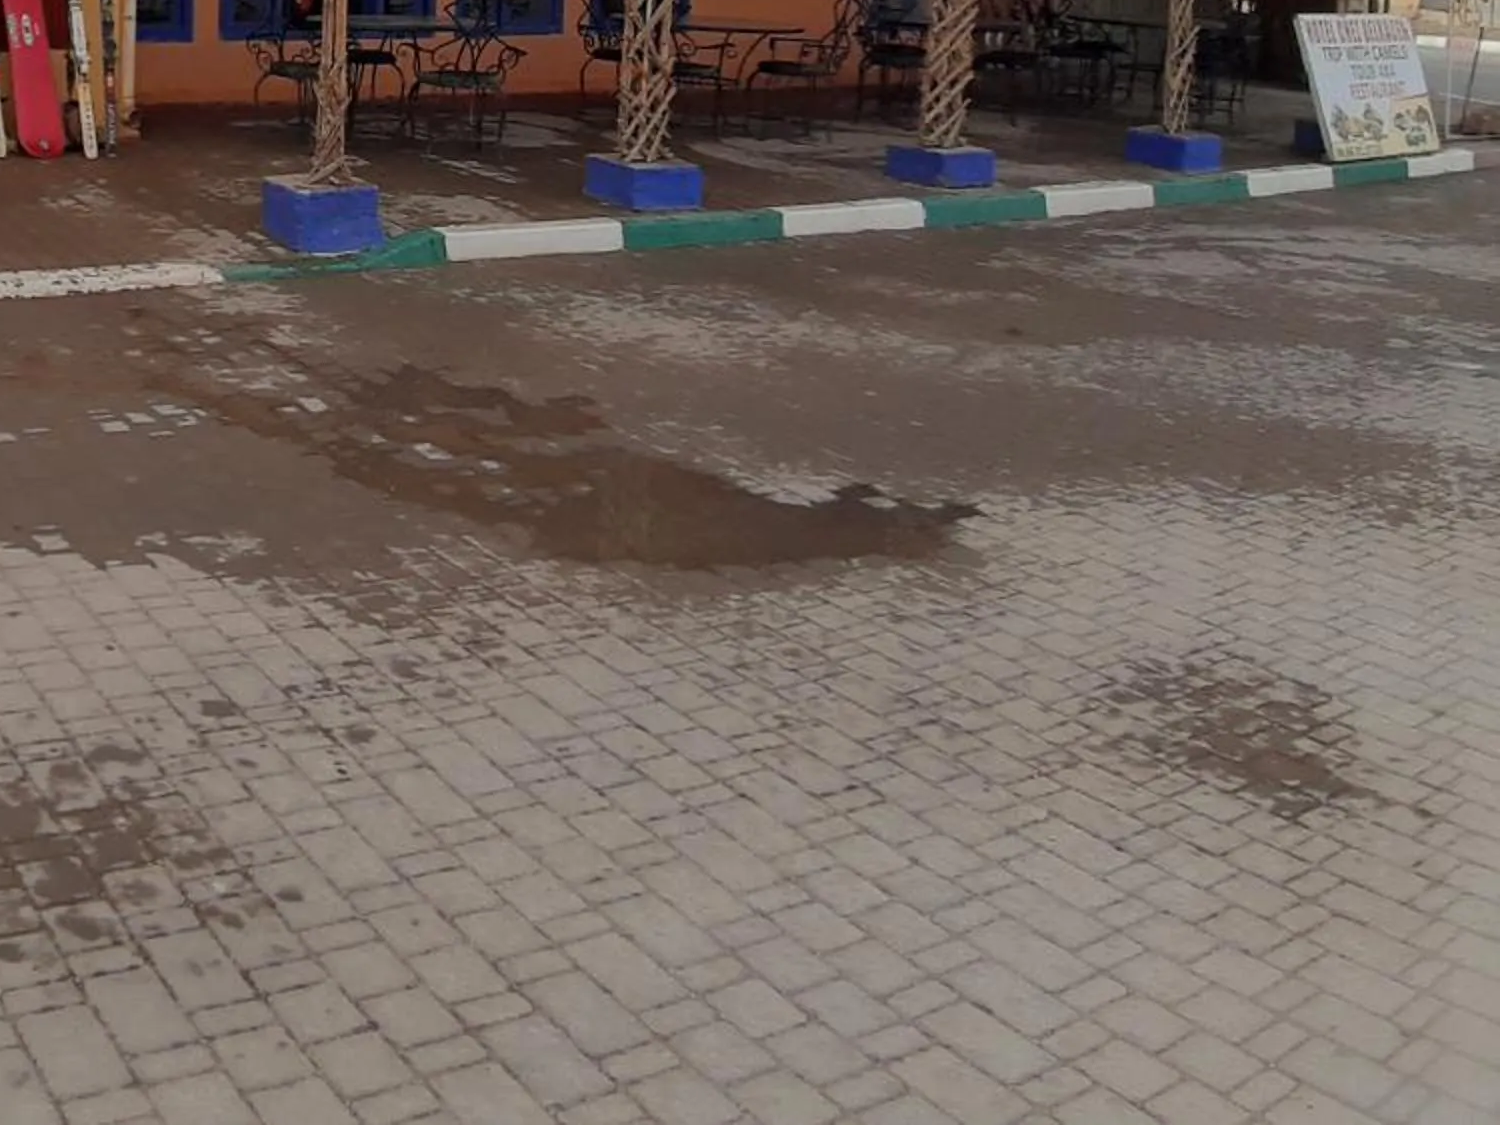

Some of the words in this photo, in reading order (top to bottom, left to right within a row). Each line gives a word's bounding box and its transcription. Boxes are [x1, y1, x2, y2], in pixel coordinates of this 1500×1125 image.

[1322, 46, 1343, 62] TRIP
[1347, 45, 1370, 60] WITH
[1372, 44, 1409, 60] CAMELS
